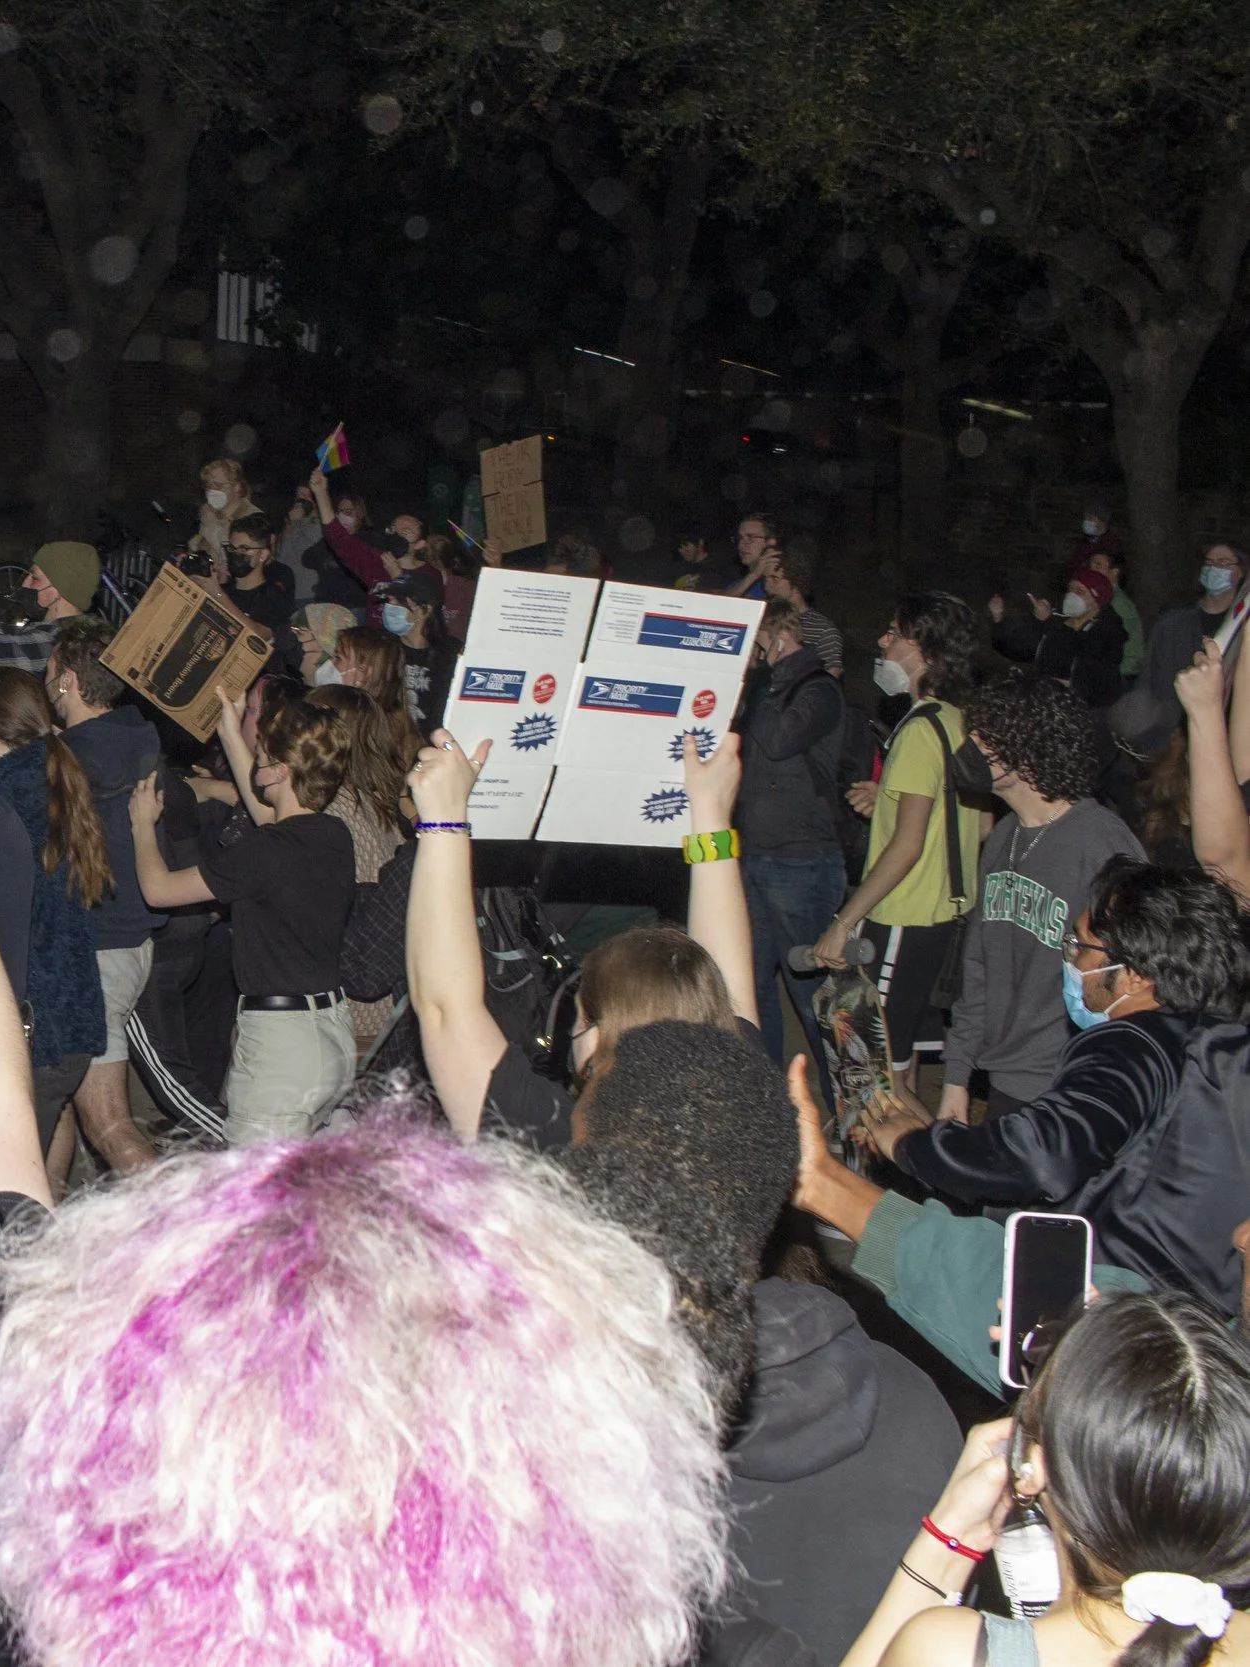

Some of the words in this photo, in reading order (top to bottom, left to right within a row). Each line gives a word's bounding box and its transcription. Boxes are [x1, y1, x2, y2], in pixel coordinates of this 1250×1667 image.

[196, 628, 218, 657] Tri-Fold
[179, 653, 201, 679] Display
[489, 673, 523, 683] PRIORITY
[163, 676, 184, 700] Board
[612, 683, 649, 694] PRIORITY
[1012, 871, 1069, 950] TEXAS
